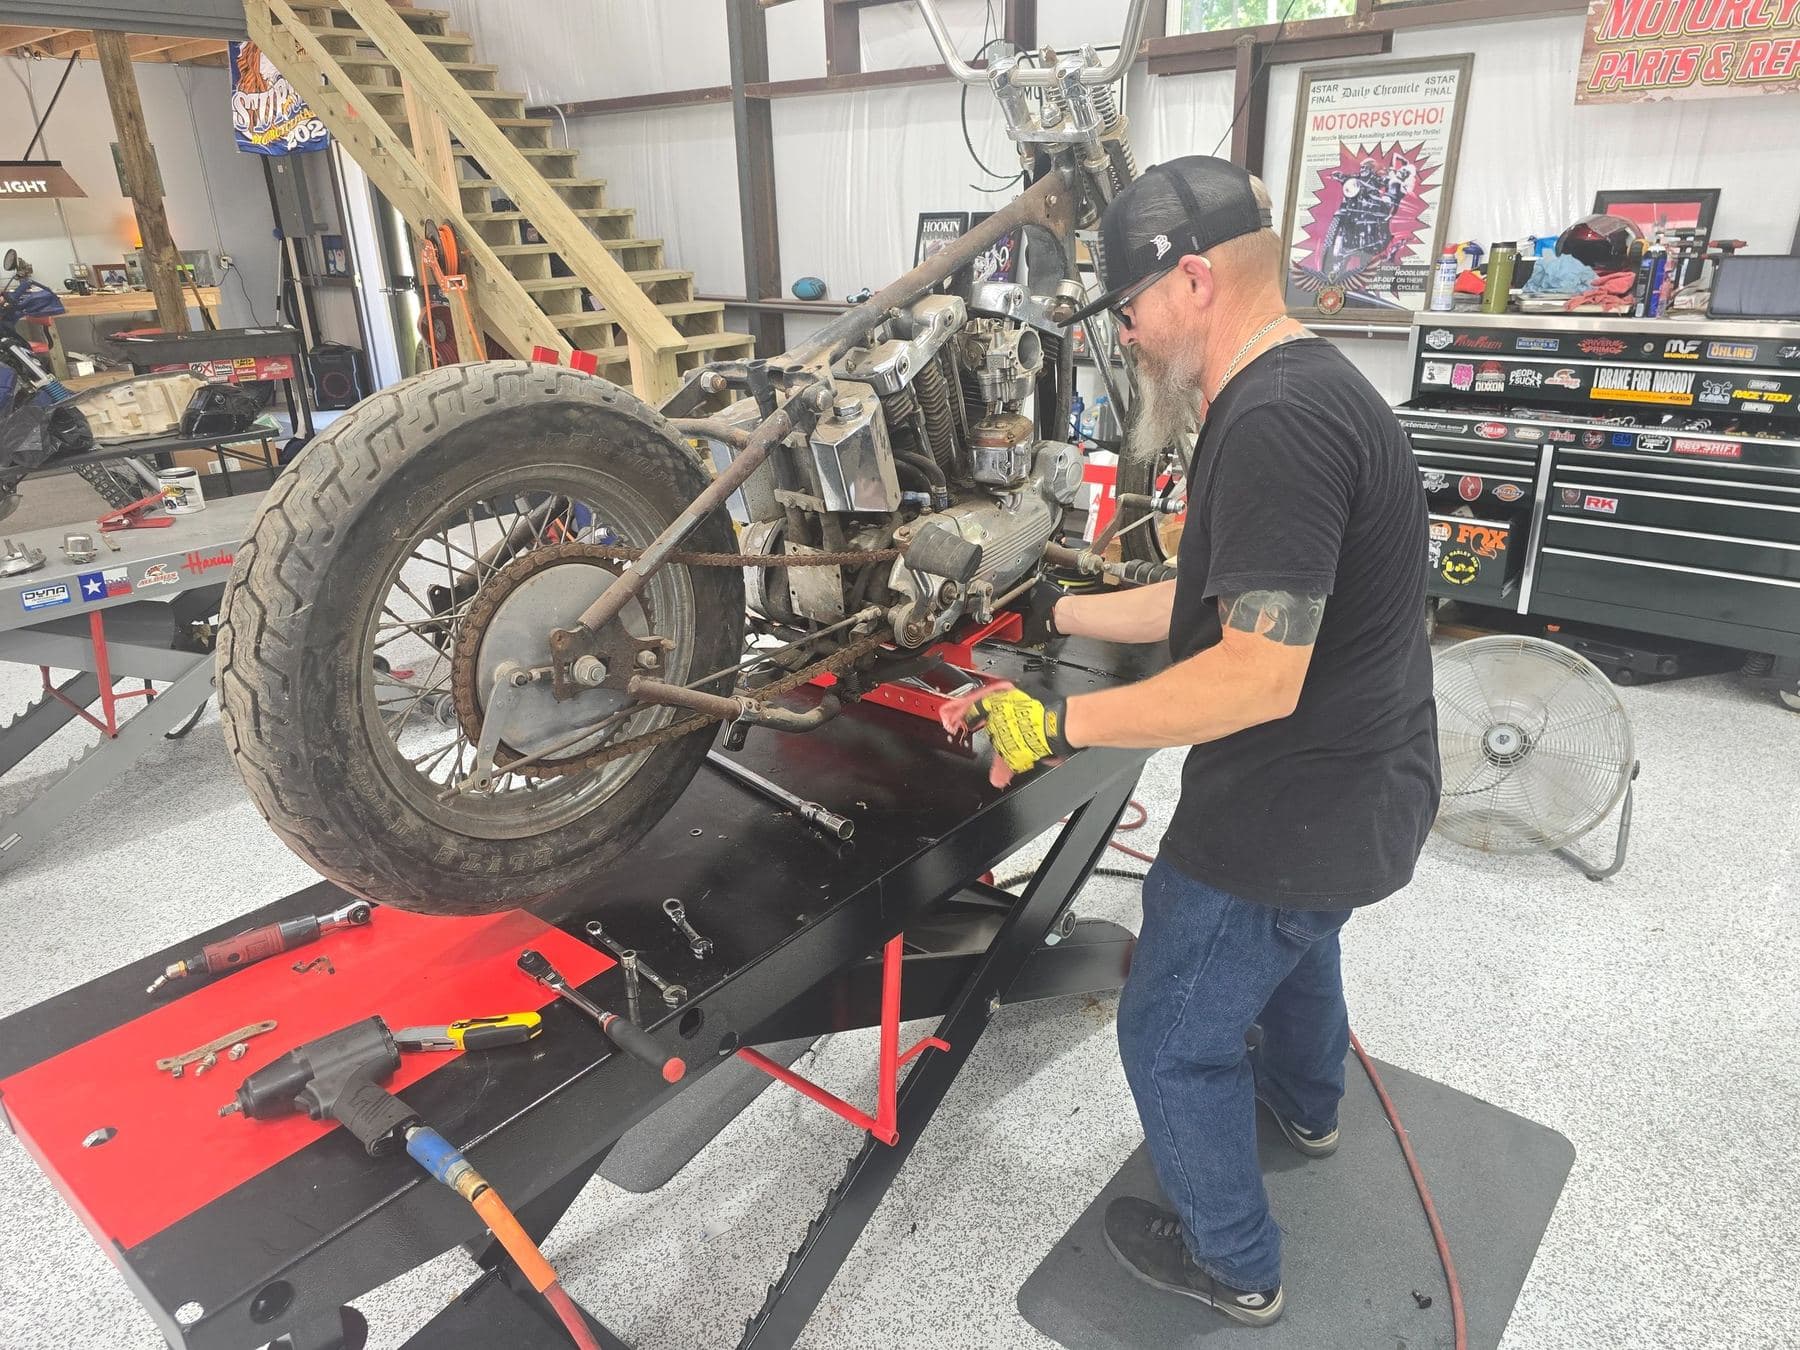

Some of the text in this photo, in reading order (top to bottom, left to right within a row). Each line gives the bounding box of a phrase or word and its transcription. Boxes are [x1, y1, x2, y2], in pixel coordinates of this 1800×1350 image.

[1597, 0, 1800, 42] MOTORCY
[1588, 47, 1702, 91] PARTS
[1701, 44, 1734, 82] &
[1311, 75, 1456, 99] 4STAR Daily Chronicle 4STAR
[1424, 87, 1453, 97] FINAL
[1311, 96, 1337, 105] FINAL
[1312, 107, 1445, 131] MOTORPSYCHO!
[1510, 368, 1543, 381] PEOPLE
[1600, 368, 1631, 390] BRAKE
[1631, 370, 1651, 391] FOR
[1652, 371, 1696, 394] NOBODY
[1586, 497, 1615, 510] RK
[1456, 524, 1509, 555] FOX
